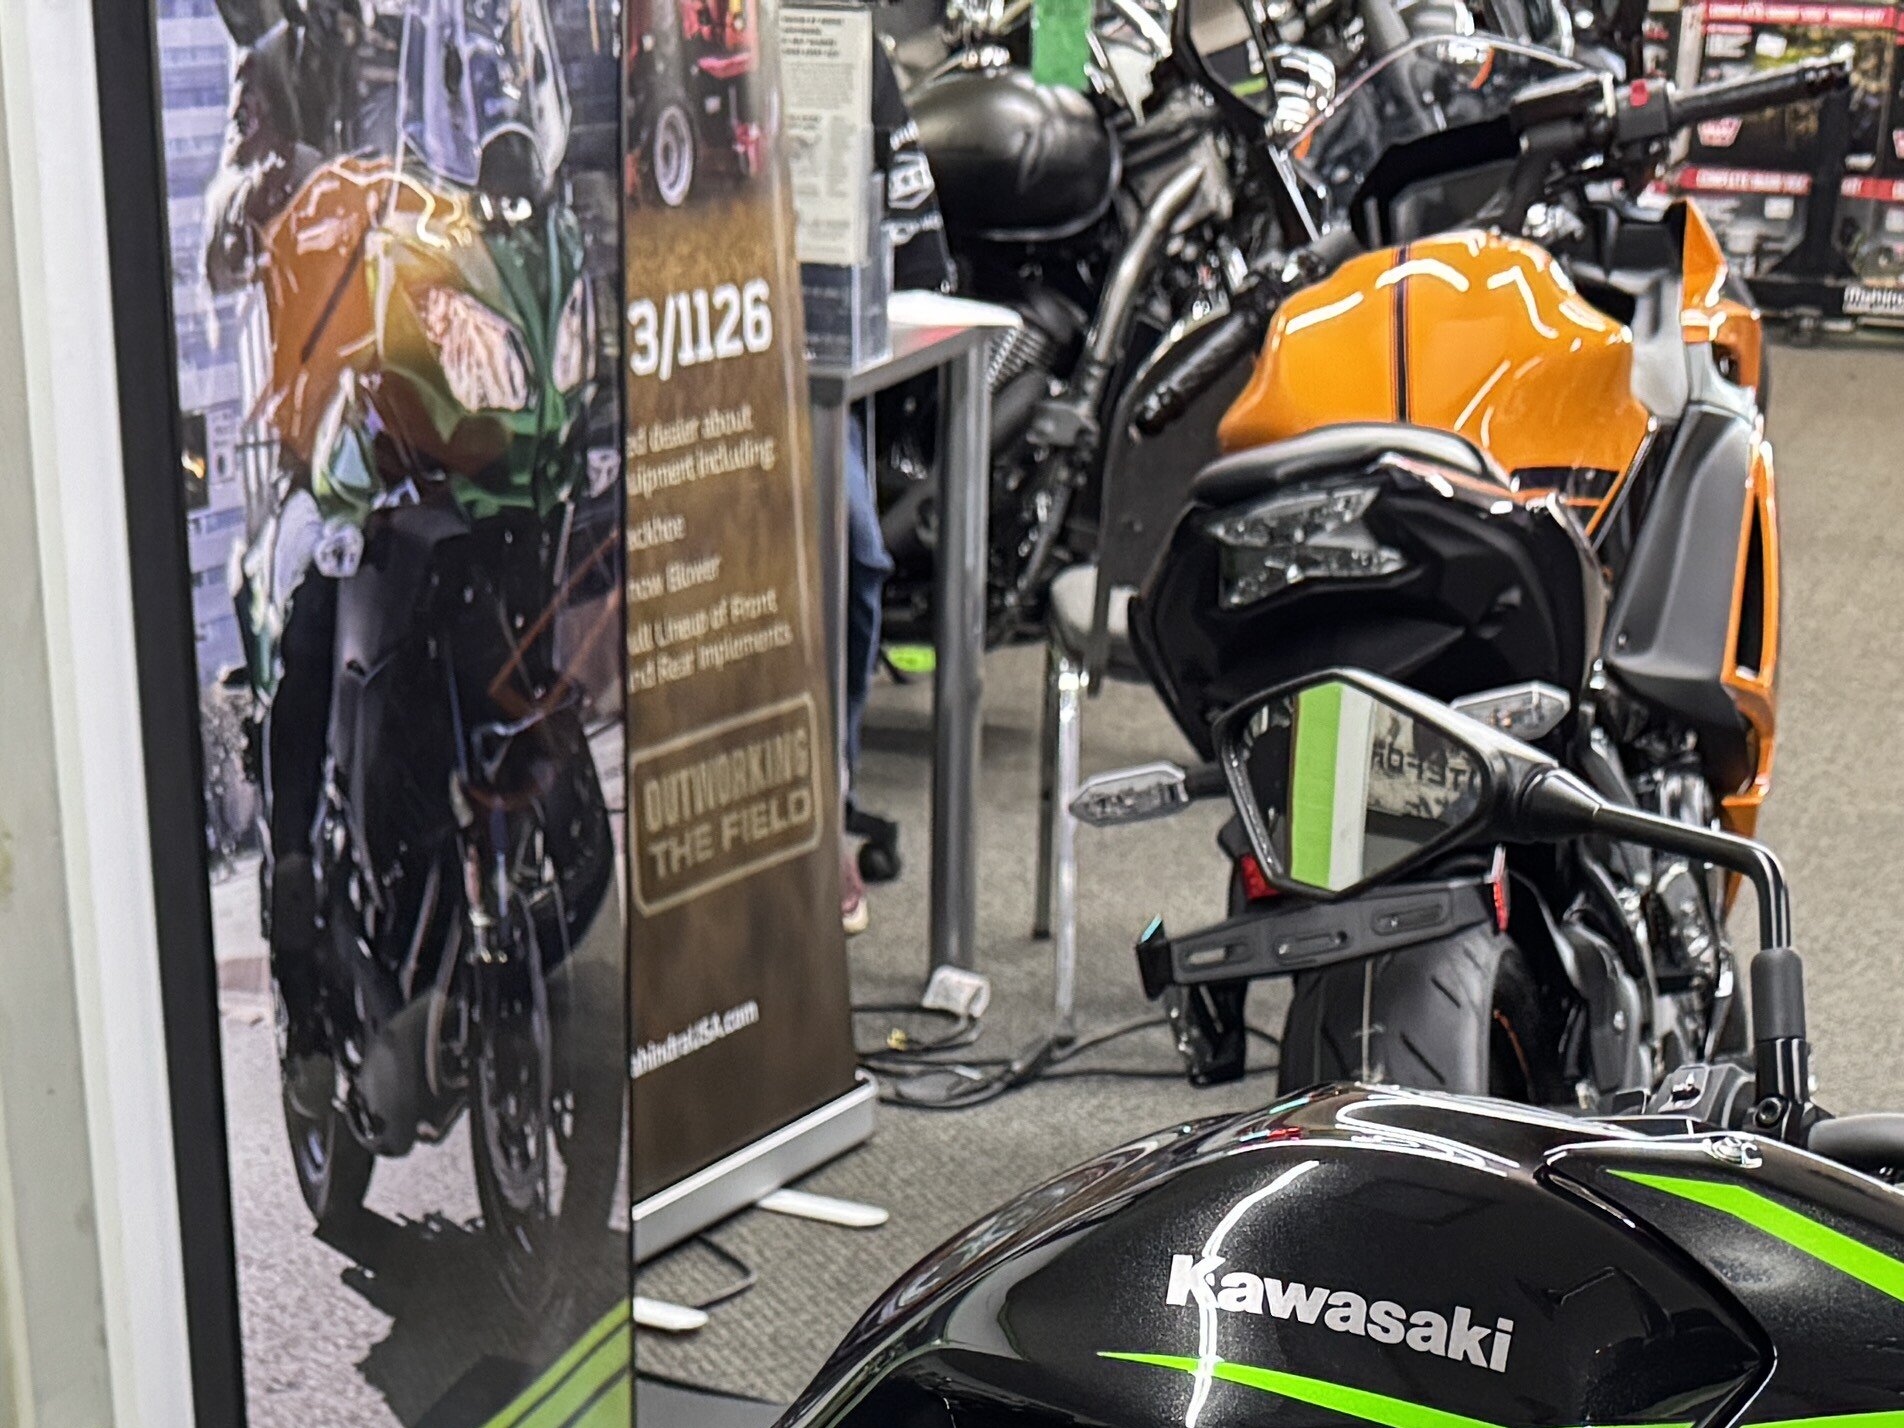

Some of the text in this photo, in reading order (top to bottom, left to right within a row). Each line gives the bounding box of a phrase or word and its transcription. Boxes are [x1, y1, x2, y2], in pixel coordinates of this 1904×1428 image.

[627, 277, 773, 381] 3/1126
[701, 404, 752, 439] about
[665, 554, 721, 593] Blower
[730, 587, 778, 624] Front
[643, 728, 809, 833] OUTWORKING
[649, 786, 812, 880] THE FIELD
[1166, 1253, 1514, 1373] Kawasaki
